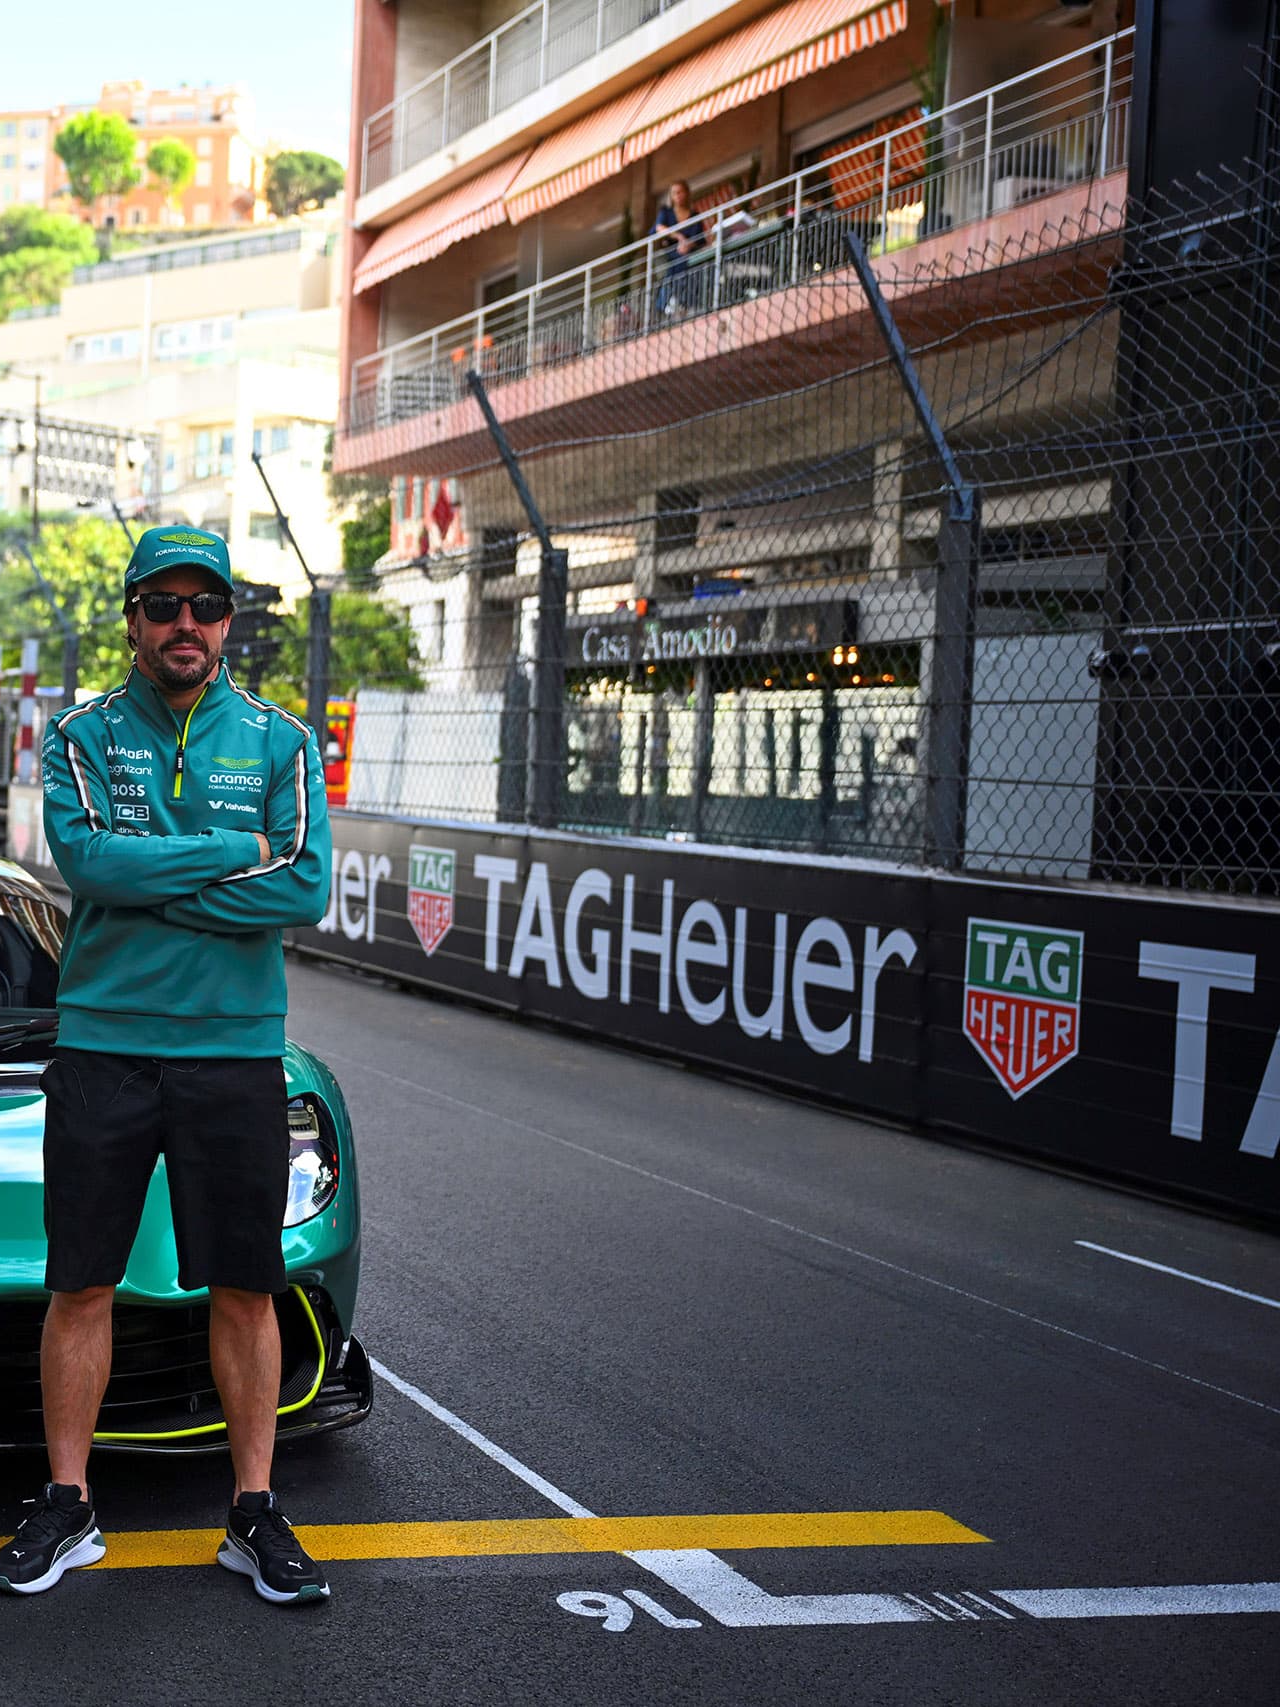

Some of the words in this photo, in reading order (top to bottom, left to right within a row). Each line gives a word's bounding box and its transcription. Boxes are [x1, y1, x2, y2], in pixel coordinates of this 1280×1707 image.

[155, 547, 188, 558] FORMULA
[204, 551, 221, 564] TEAM
[582, 626, 631, 662] Casa
[642, 615, 738, 662] Amodio
[111, 783, 146, 798] BOSS
[209, 774, 263, 786] aramco
[224, 802, 258, 814] Valvoline
[412, 854, 452, 890] TAG
[410, 893, 451, 947] HEUER
[473, 854, 918, 1063] TAGHeuer
[976, 930, 1071, 995] TAG
[970, 996, 1072, 1086] HEUER
[1138, 940, 1280, 1159] T
